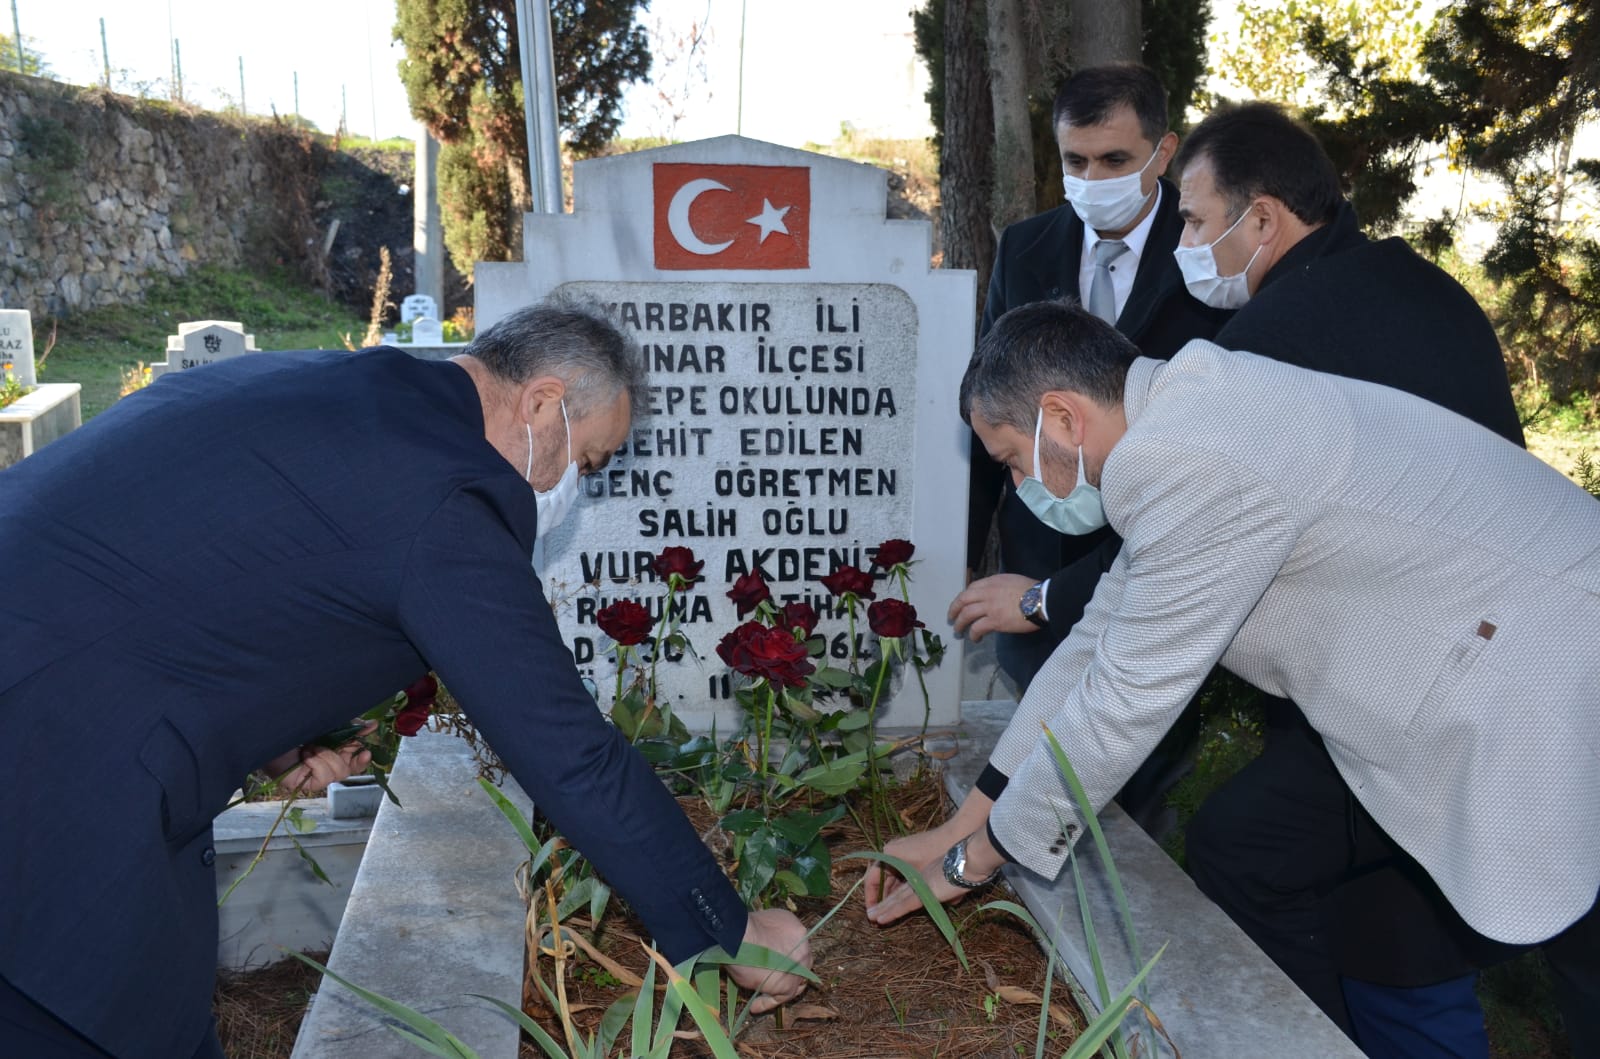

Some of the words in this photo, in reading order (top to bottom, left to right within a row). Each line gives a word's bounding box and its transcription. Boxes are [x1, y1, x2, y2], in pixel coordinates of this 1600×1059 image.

[815, 297, 859, 333] İLİ
[643, 344, 726, 373] INAR
[758, 336, 864, 380] İLÇESİ
[646, 386, 706, 416] EPE
[719, 385, 897, 418] OKULUNDA
[740, 421, 862, 456] EDİLEN
[715, 461, 896, 498] ÖĞRETMEN
[639, 502, 737, 537] SALİH
[763, 501, 848, 536] OĞLU
